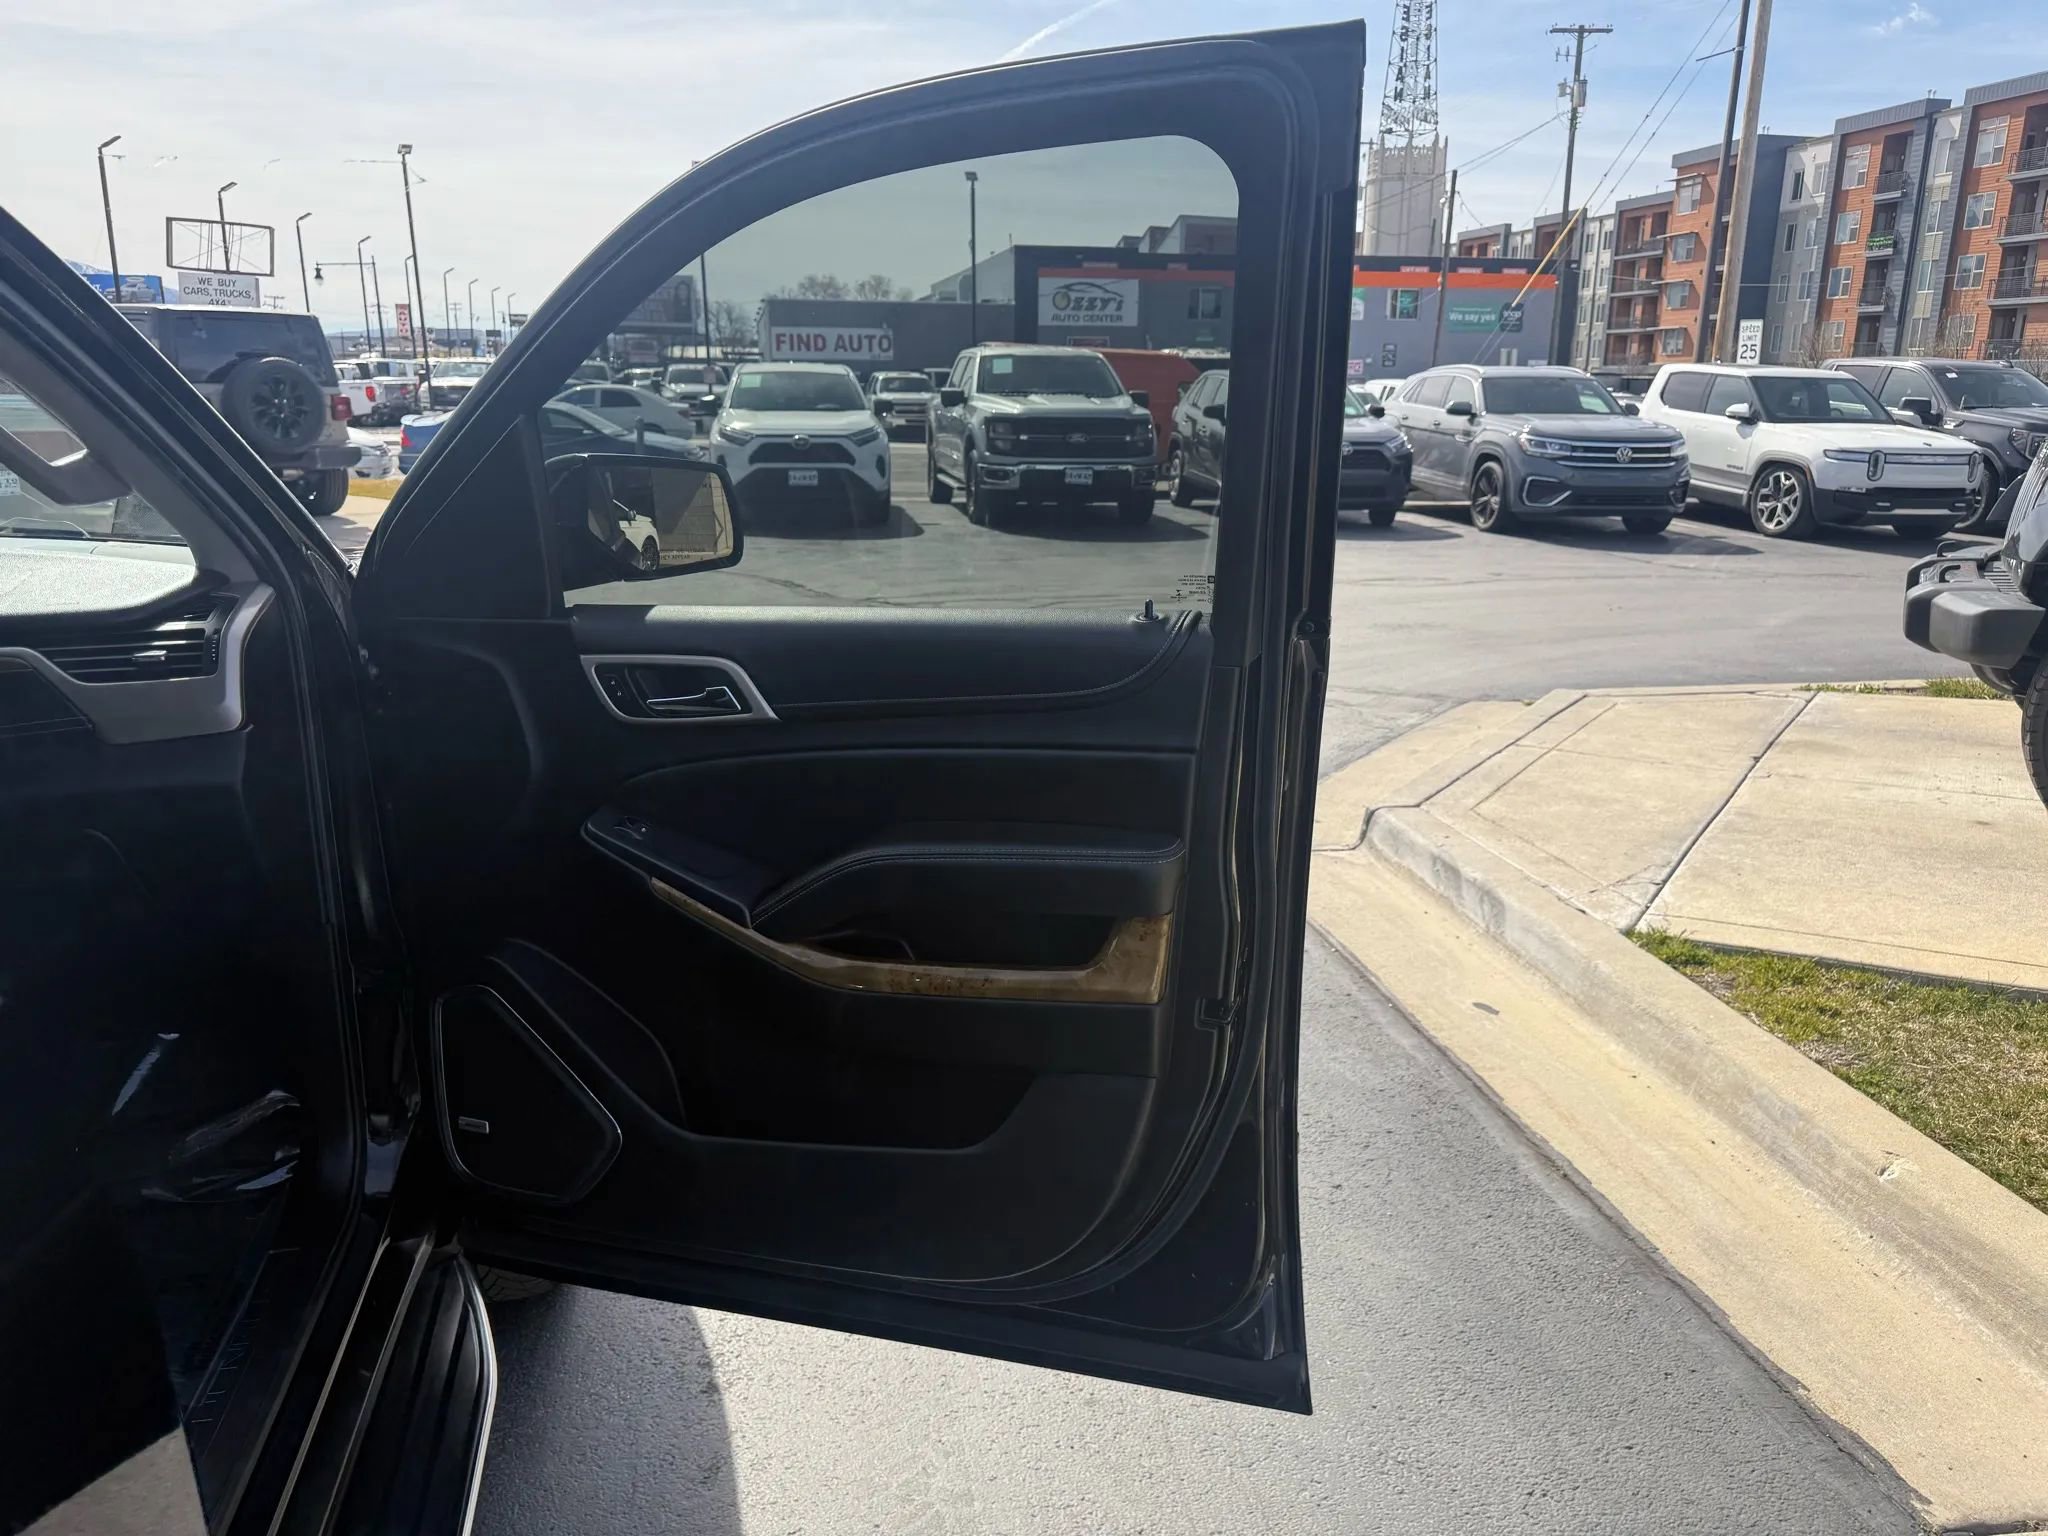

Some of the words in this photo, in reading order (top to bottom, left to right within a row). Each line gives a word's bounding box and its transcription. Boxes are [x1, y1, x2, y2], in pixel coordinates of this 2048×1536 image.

[197, 276, 213, 286] WE
[217, 278, 237, 288] BUY
[212, 288, 255, 301] TRUCKS,
[1051, 313, 1081, 323] AUTO
[1082, 313, 1124, 324] CENTER
[1449, 311, 1464, 321] We
[1464, 313, 1479, 323] say
[1480, 313, 1496, 323] yes
[775, 332, 827, 352] FIND
[833, 333, 893, 353] AUTO
[1742, 334, 1758, 342] LIMIT
[1740, 344, 1758, 360] 25
